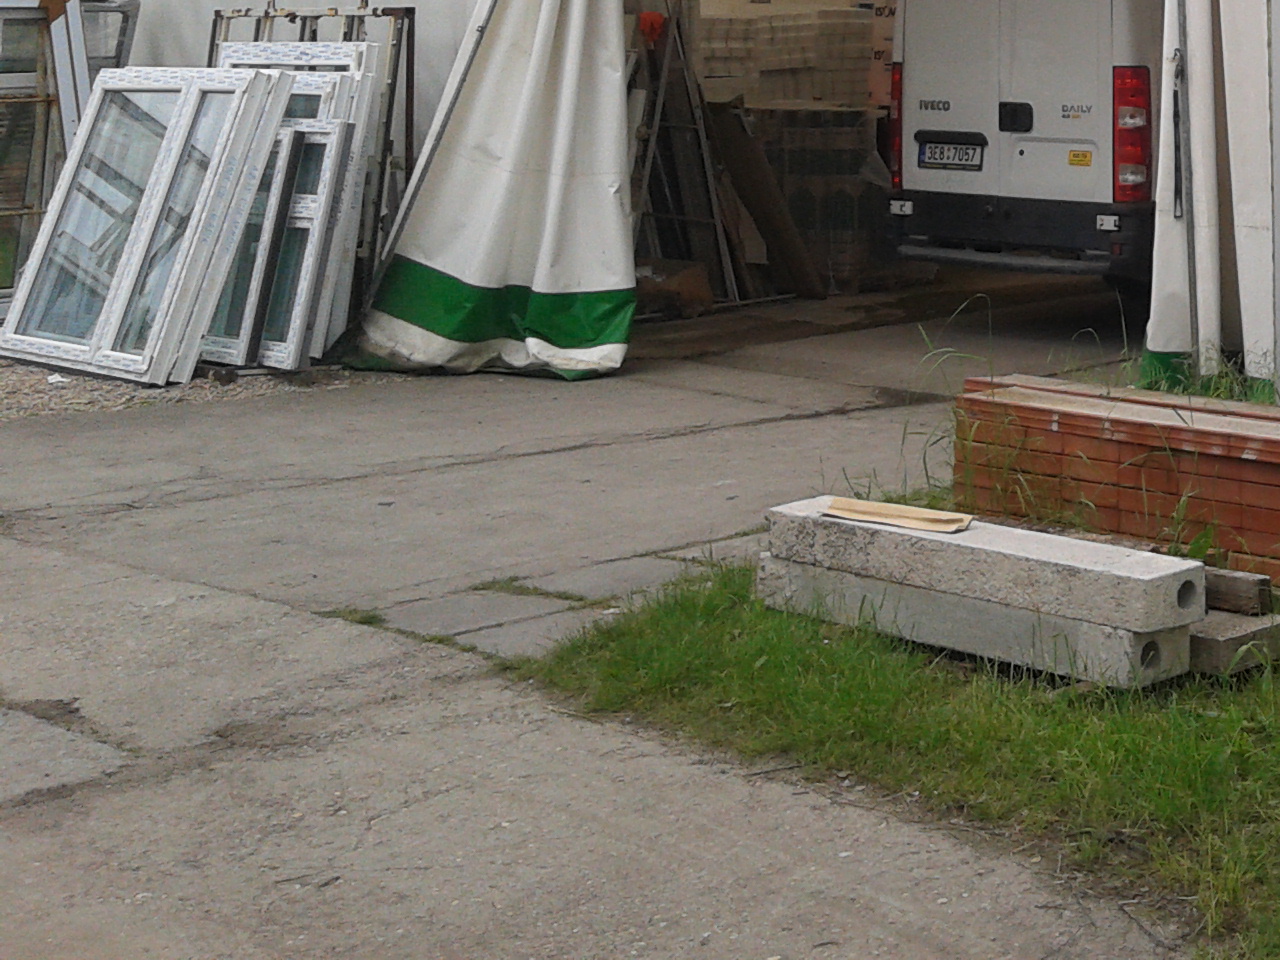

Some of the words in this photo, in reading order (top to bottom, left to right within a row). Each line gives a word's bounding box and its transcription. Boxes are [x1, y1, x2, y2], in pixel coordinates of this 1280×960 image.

[919, 100, 950, 111] IVECO
[1061, 104, 1092, 113] DAILY
[952, 146, 977, 162] 7057
